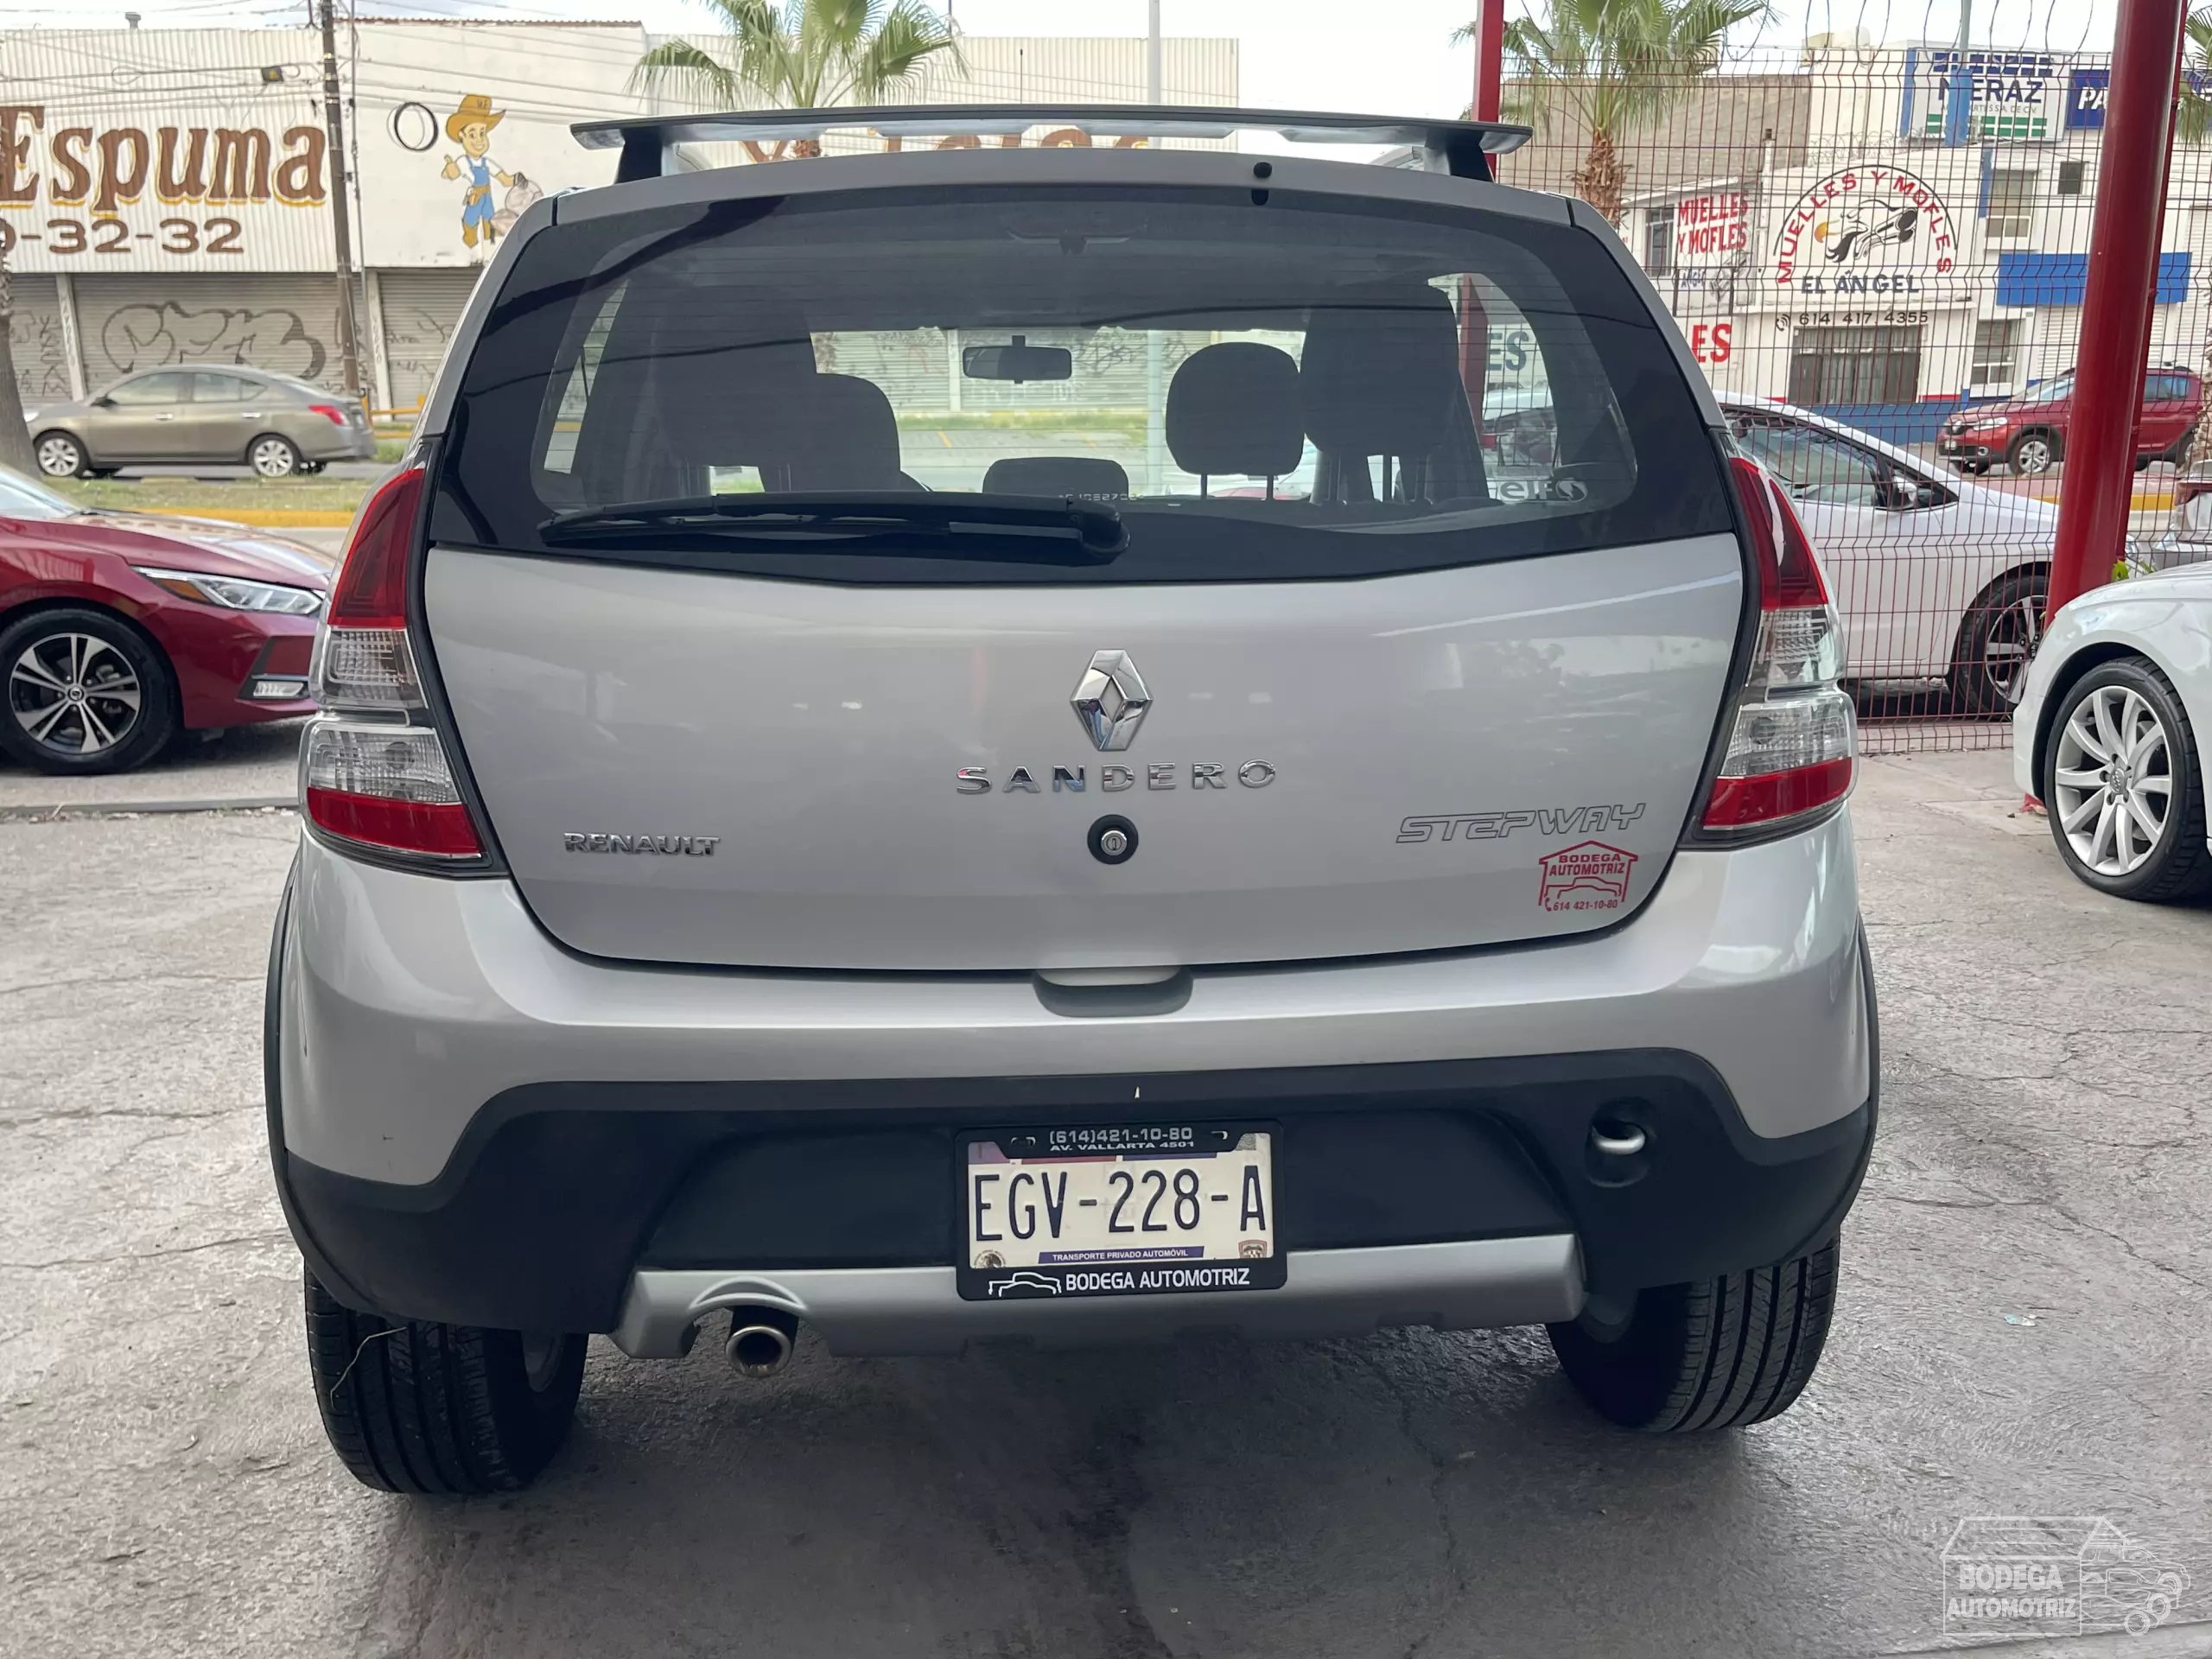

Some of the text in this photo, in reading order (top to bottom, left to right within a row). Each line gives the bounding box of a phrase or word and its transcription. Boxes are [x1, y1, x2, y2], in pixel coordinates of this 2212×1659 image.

[0, 105, 327, 218] Espuma
[1678, 189, 1749, 228] MUELLES
[1777, 169, 1953, 284] MUELLES Y MOFLES
[1677, 222, 1748, 255] Y MOFLES
[1801, 275, 1827, 295] EL
[1799, 311, 1831, 326] 614
[1884, 310, 1929, 324] 4355
[1500, 480, 1554, 500] elf
[957, 759, 1277, 795] SANDERO
[1395, 803, 1646, 843] STEPWAY
[563, 832, 721, 856] RENAULT
[1558, 854, 1622, 863] BODEGA
[1548, 863, 1625, 876] AUTOMOTRIZ
[1553, 899, 1618, 912] 614 421-10-80
[1049, 1128, 1193, 1144] (614)421-10-80
[1077, 1141, 1156, 1151] VALLARTA
[975, 1165, 1266, 1242] EGV-228-A
[1052, 1248, 1188, 1262] TRANSPORTE PRIVADO AUTOMÓVIL
[1065, 1268, 1250, 1291] BODEGA AUTOMOTRIZ
